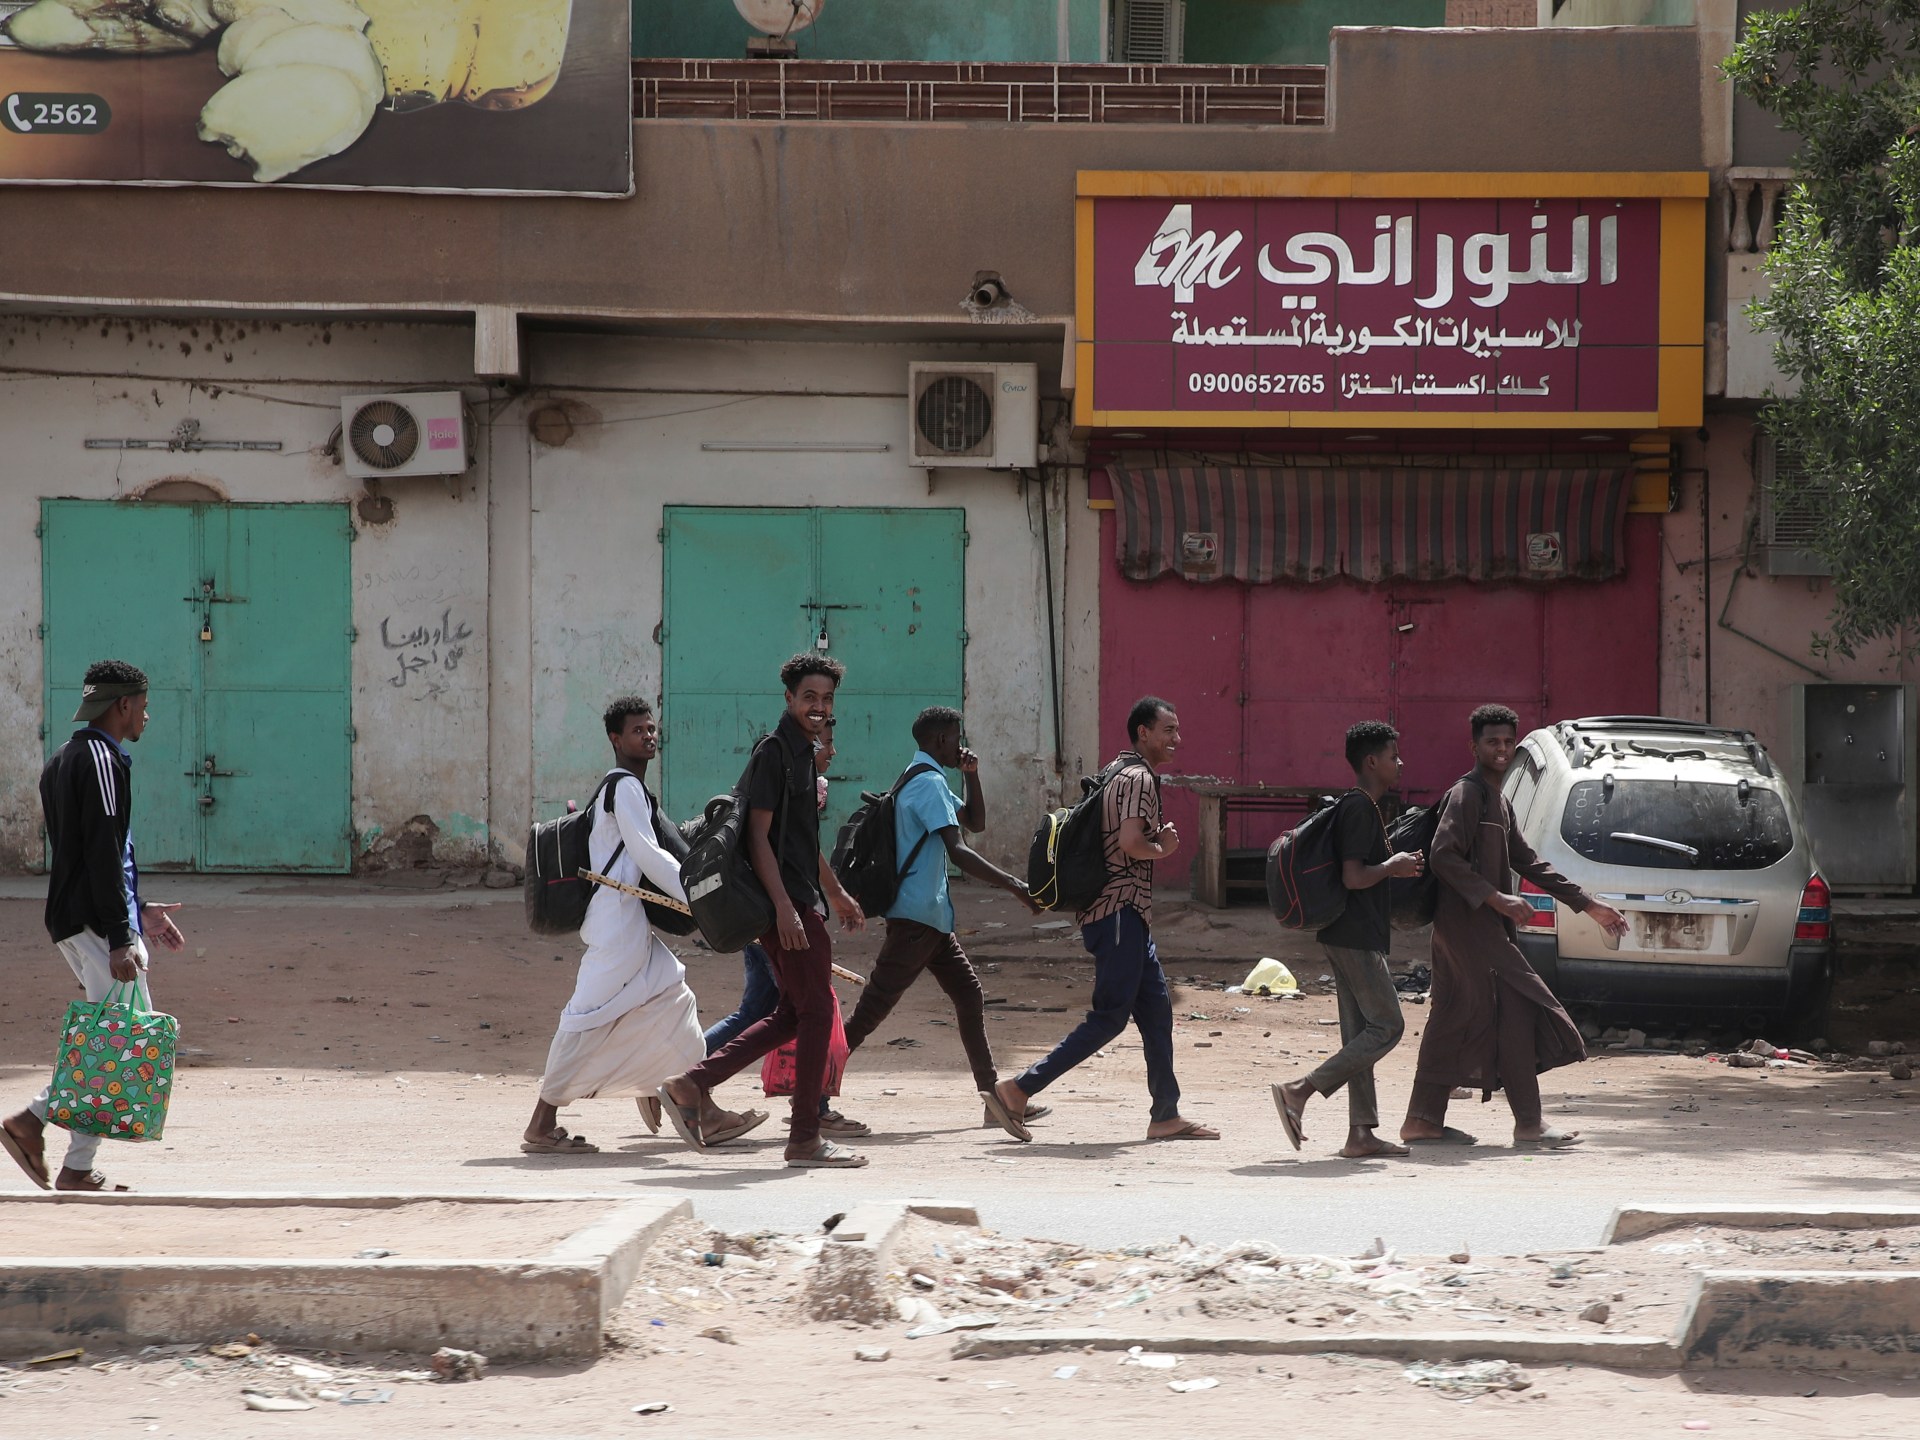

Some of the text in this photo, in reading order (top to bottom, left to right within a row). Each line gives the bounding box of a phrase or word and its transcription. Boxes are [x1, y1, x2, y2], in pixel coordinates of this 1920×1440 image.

[33, 103, 97, 125] 2562
[1257, 214, 1618, 310] النوراني
[1170, 310, 1583, 359] للاسبيرات الكورية المستعملة
[1188, 372, 1325, 394] 0900652765
